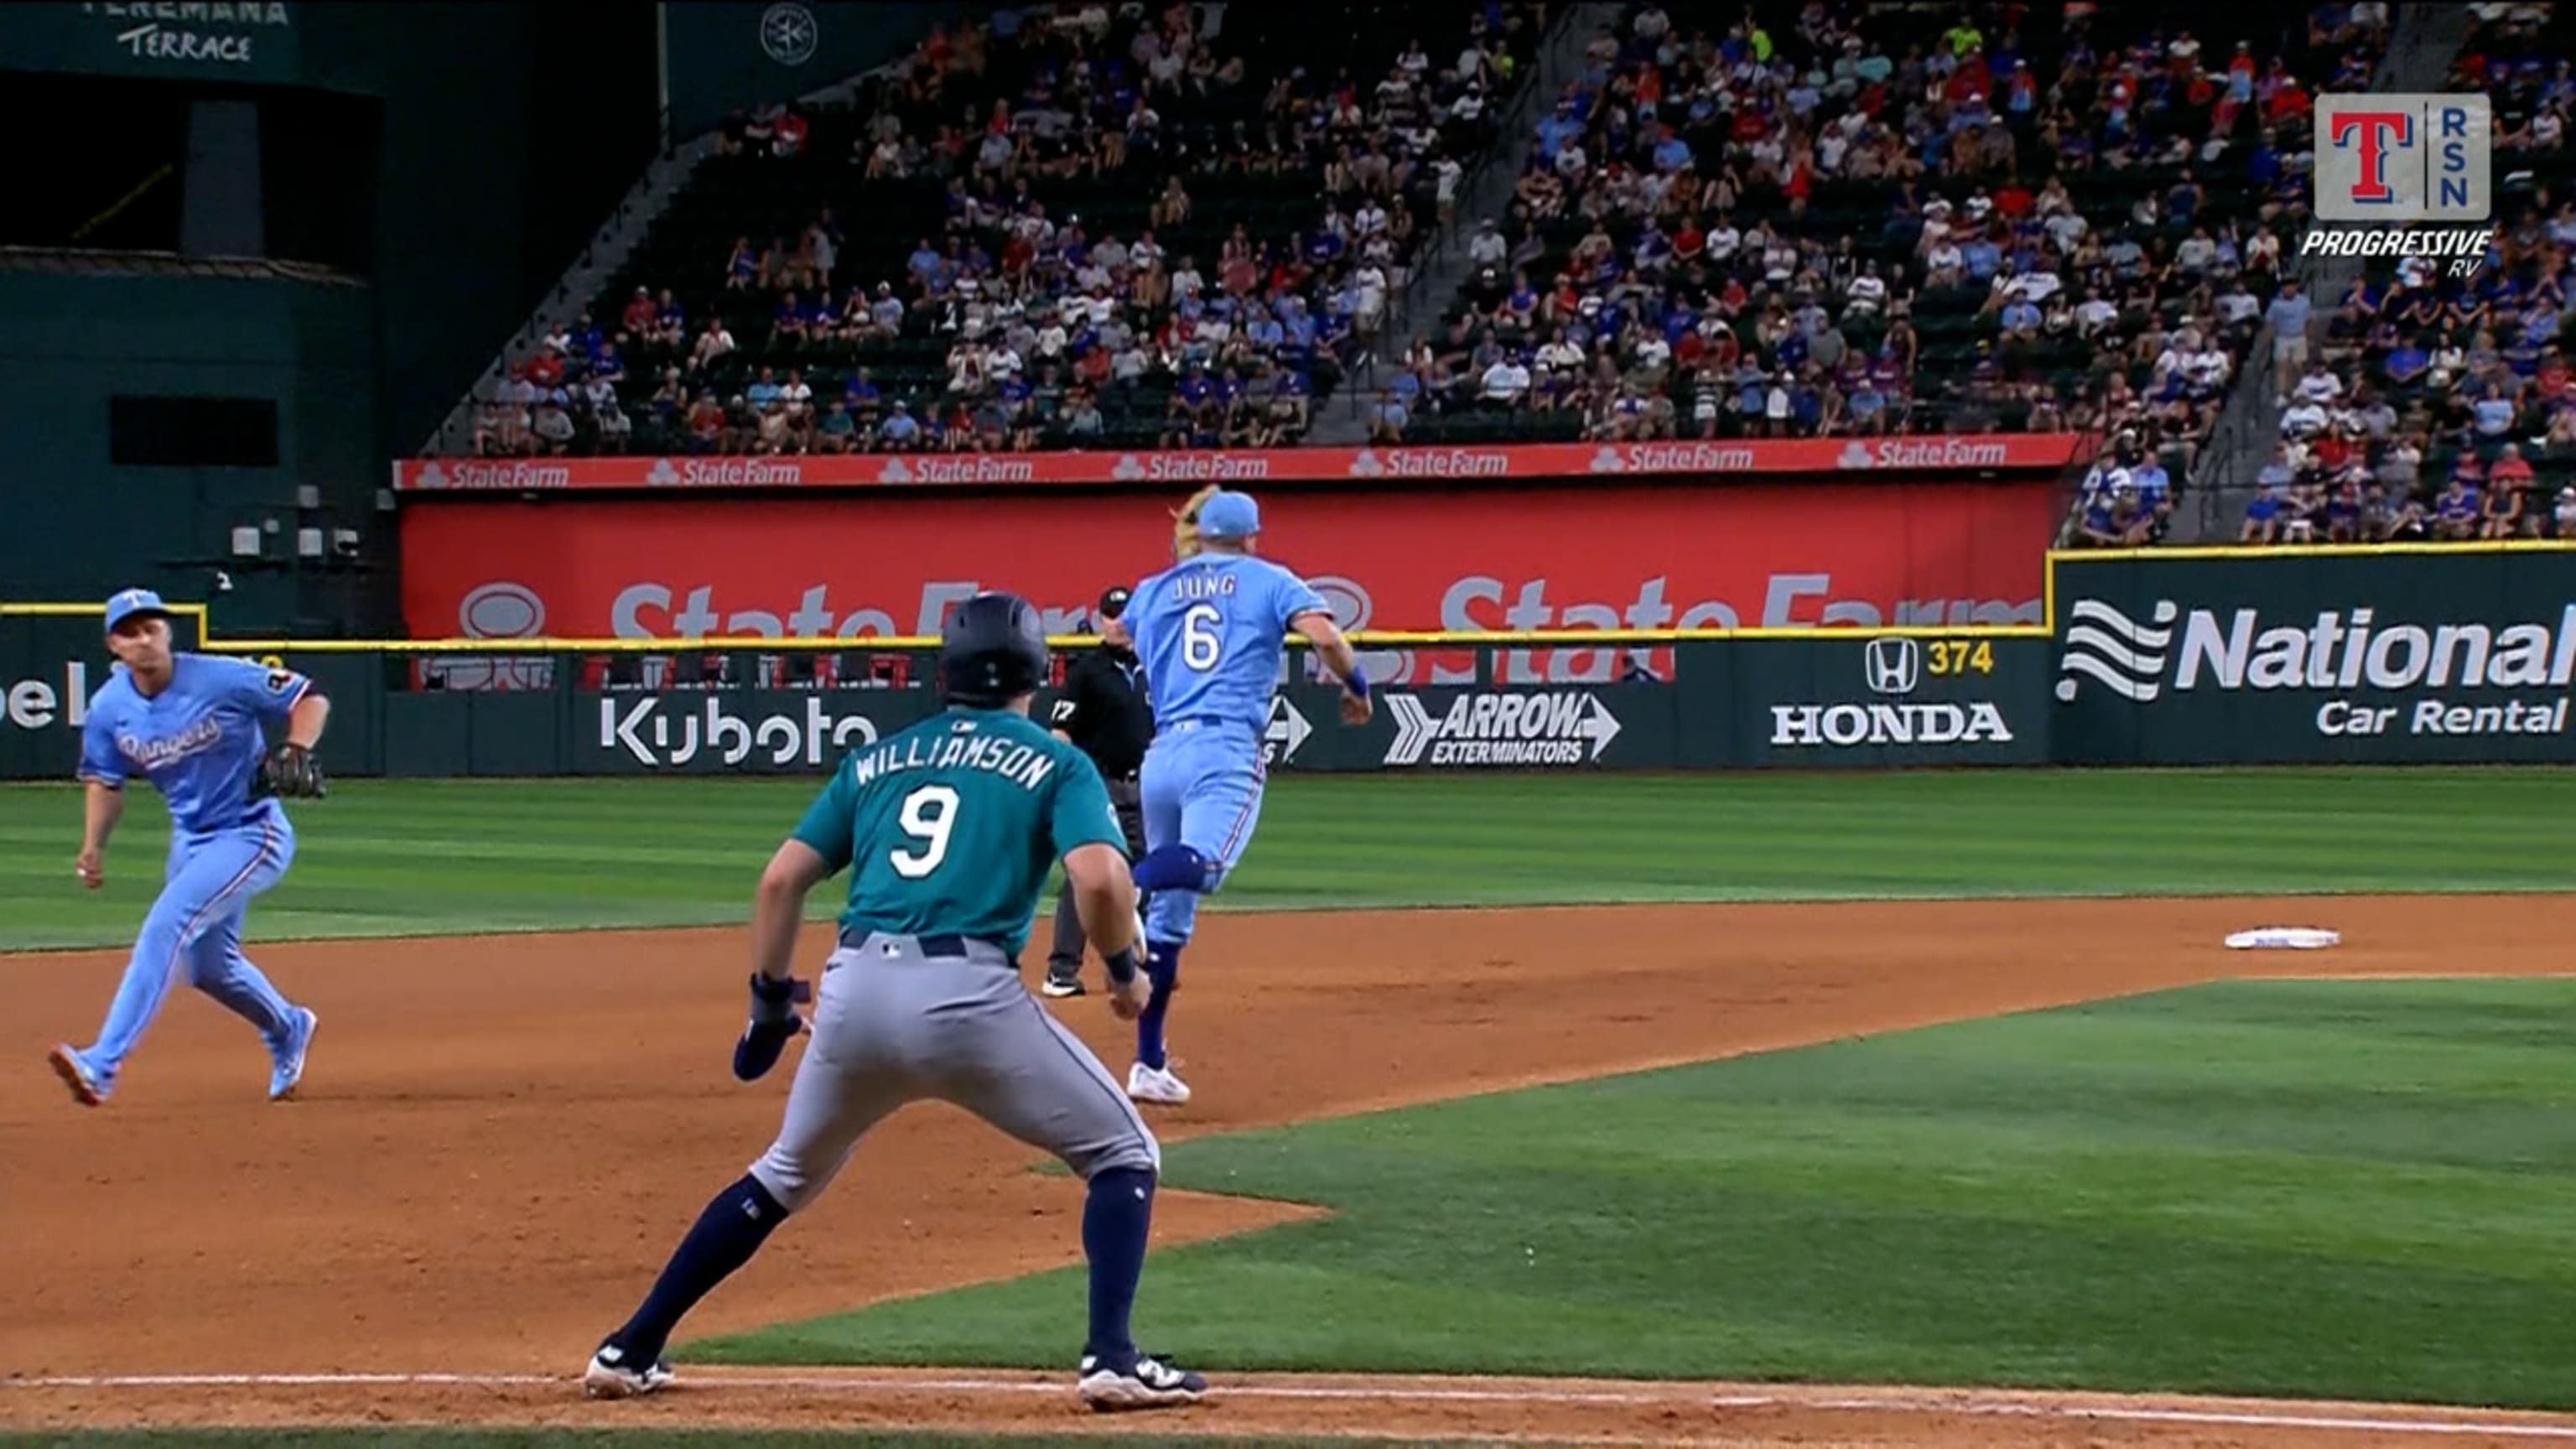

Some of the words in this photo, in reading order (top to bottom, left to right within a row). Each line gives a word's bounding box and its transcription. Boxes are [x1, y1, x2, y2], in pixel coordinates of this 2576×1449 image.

[82, 2, 288, 25] EREMANA
[117, 23, 251, 61] TERRACE
[1174, 574, 1235, 599] JUNG
[1183, 603, 1221, 672] 6
[2175, 605, 2576, 689] National
[1928, 641, 1994, 674] 374
[1051, 699, 1075, 720] 17
[1438, 692, 1591, 740] ARROW
[1771, 703, 2013, 744] HONDA
[2317, 700, 2397, 735] Car
[2411, 698, 2568, 734] Rental
[855, 736, 1056, 791] WILLIAMSON
[1431, 741, 1582, 765] EXTERMINATORS
[891, 784, 959, 878] 9
